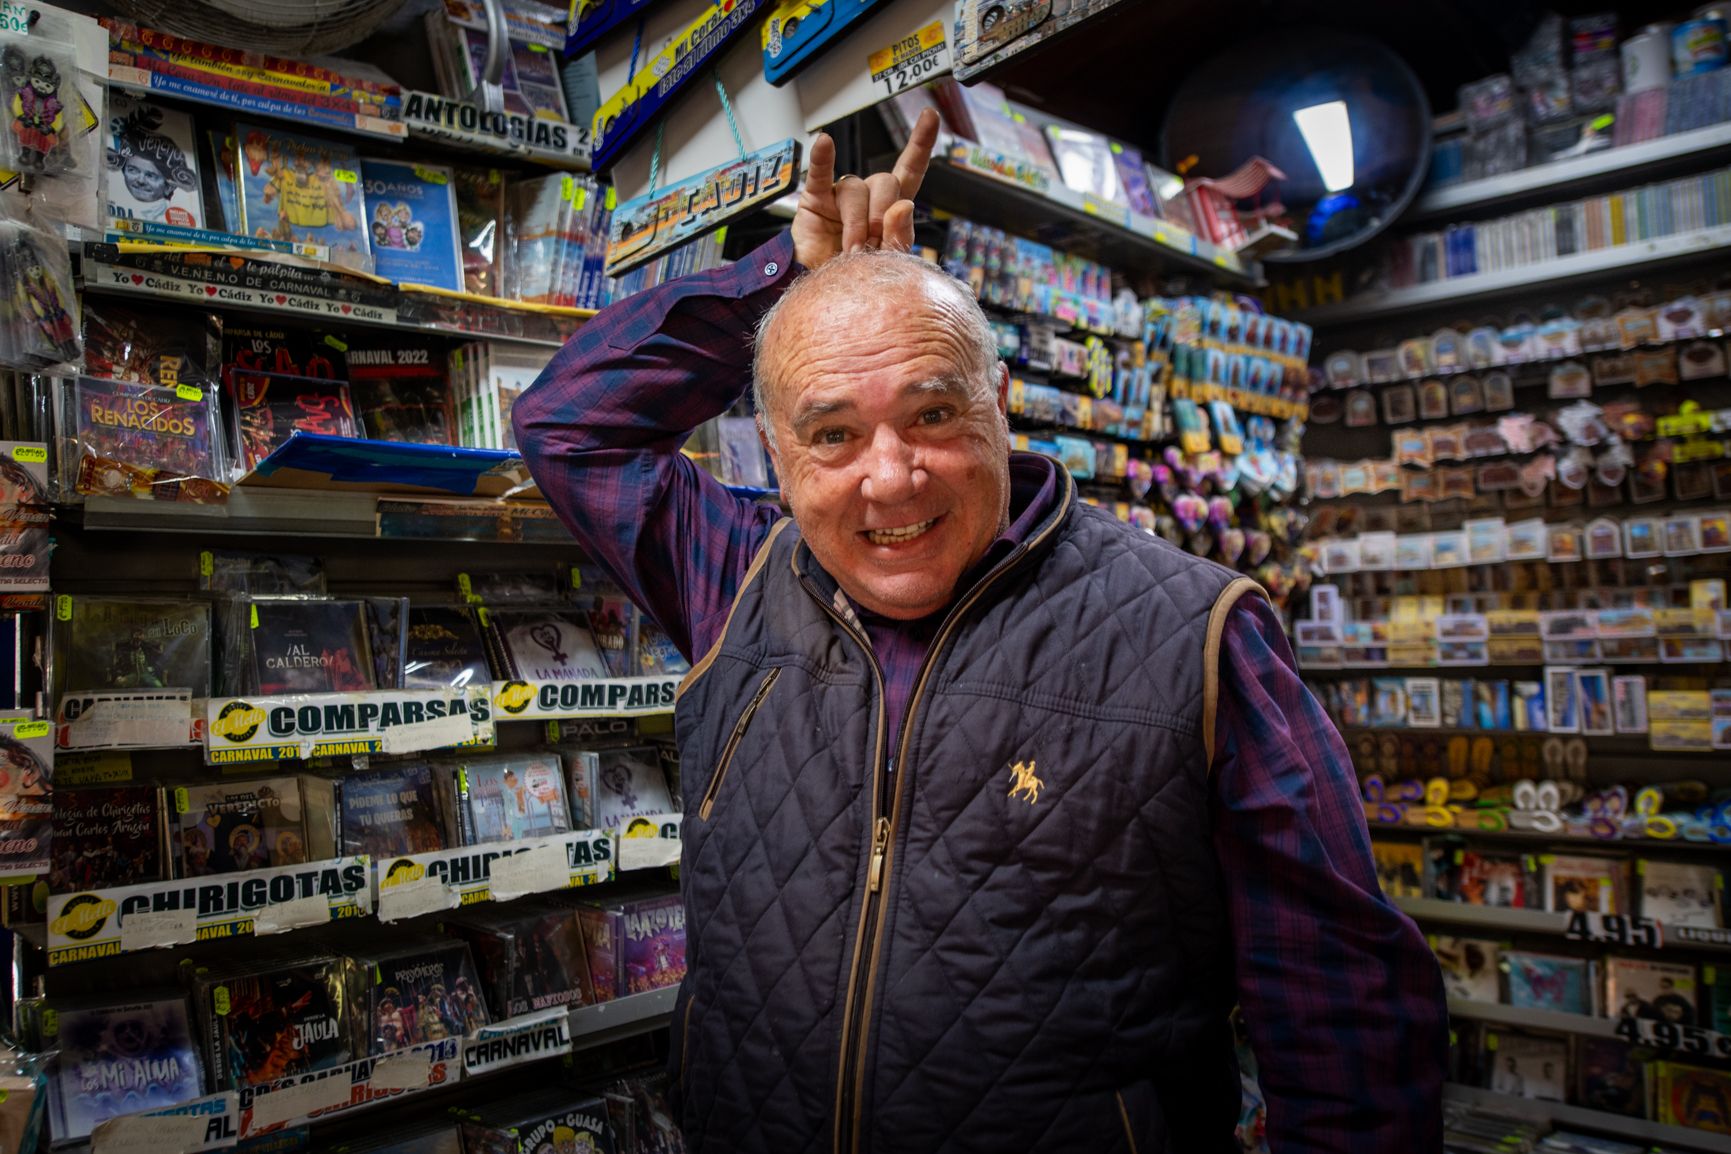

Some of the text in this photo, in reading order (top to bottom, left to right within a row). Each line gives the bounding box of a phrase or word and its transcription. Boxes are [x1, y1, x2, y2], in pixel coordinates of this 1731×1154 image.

[892, 33, 920, 55] PITOS
[884, 54, 939, 94] 12,00€
[153, 74, 168, 88] Yo
[169, 79, 182, 89] me
[183, 83, 219, 98] enamoré
[219, 91, 230, 101] de
[257, 98, 281, 113] culpa
[282, 103, 293, 113] de
[113, 271, 384, 320] Yo Cádiz Yo Cádiz Yo Cádiz Yo Cádiz
[246, 275, 262, 288] DE
[269, 279, 331, 298] CARNAVAL
[250, 338, 272, 354] LOS
[397, 349, 429, 365] 2022
[127, 398, 159, 417] LOS
[90, 402, 196, 437] RENACIDOS
[535, 668, 552, 680] LA
[538, 682, 681, 710] COMPARS
[269, 698, 491, 736] COMPARSAS
[562, 719, 628, 737] PALO
[211, 747, 274, 763] CARNAVAL
[278, 745, 300, 759] 201
[313, 741, 371, 757] CARNAVAL
[86, 801, 151, 823] de Chirigotas
[76, 821, 110, 838] Carlos
[49, 940, 121, 968] CARNAVAL
[292, 1016, 340, 1050] JAULA
[465, 1026, 571, 1068] CARNAVAL
[565, 1112, 604, 1136] GUASA
